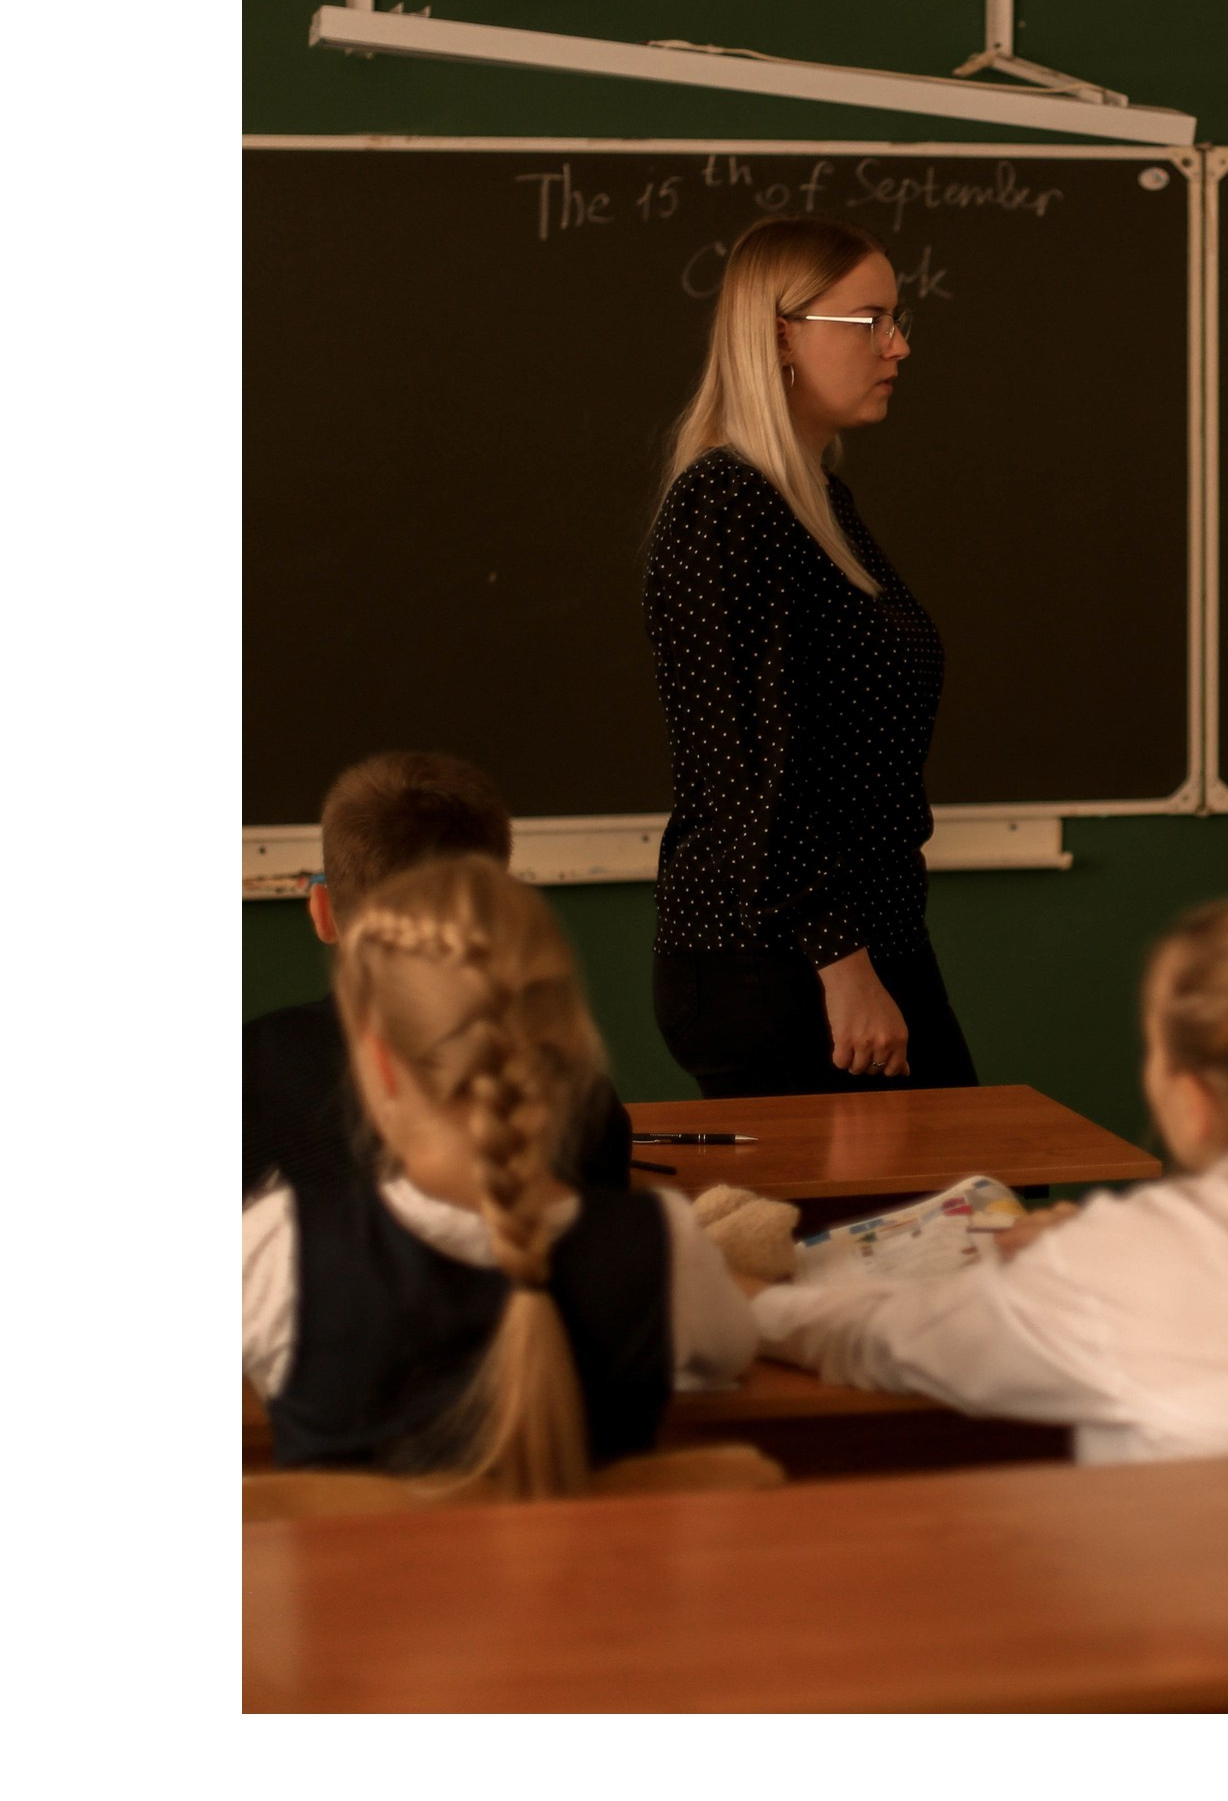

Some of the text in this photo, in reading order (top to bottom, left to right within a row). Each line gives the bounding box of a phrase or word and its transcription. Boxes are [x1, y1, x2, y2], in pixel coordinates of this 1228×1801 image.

[514, 162, 616, 242] The
[755, 160, 836, 213] of
[847, 158, 1065, 233] September
